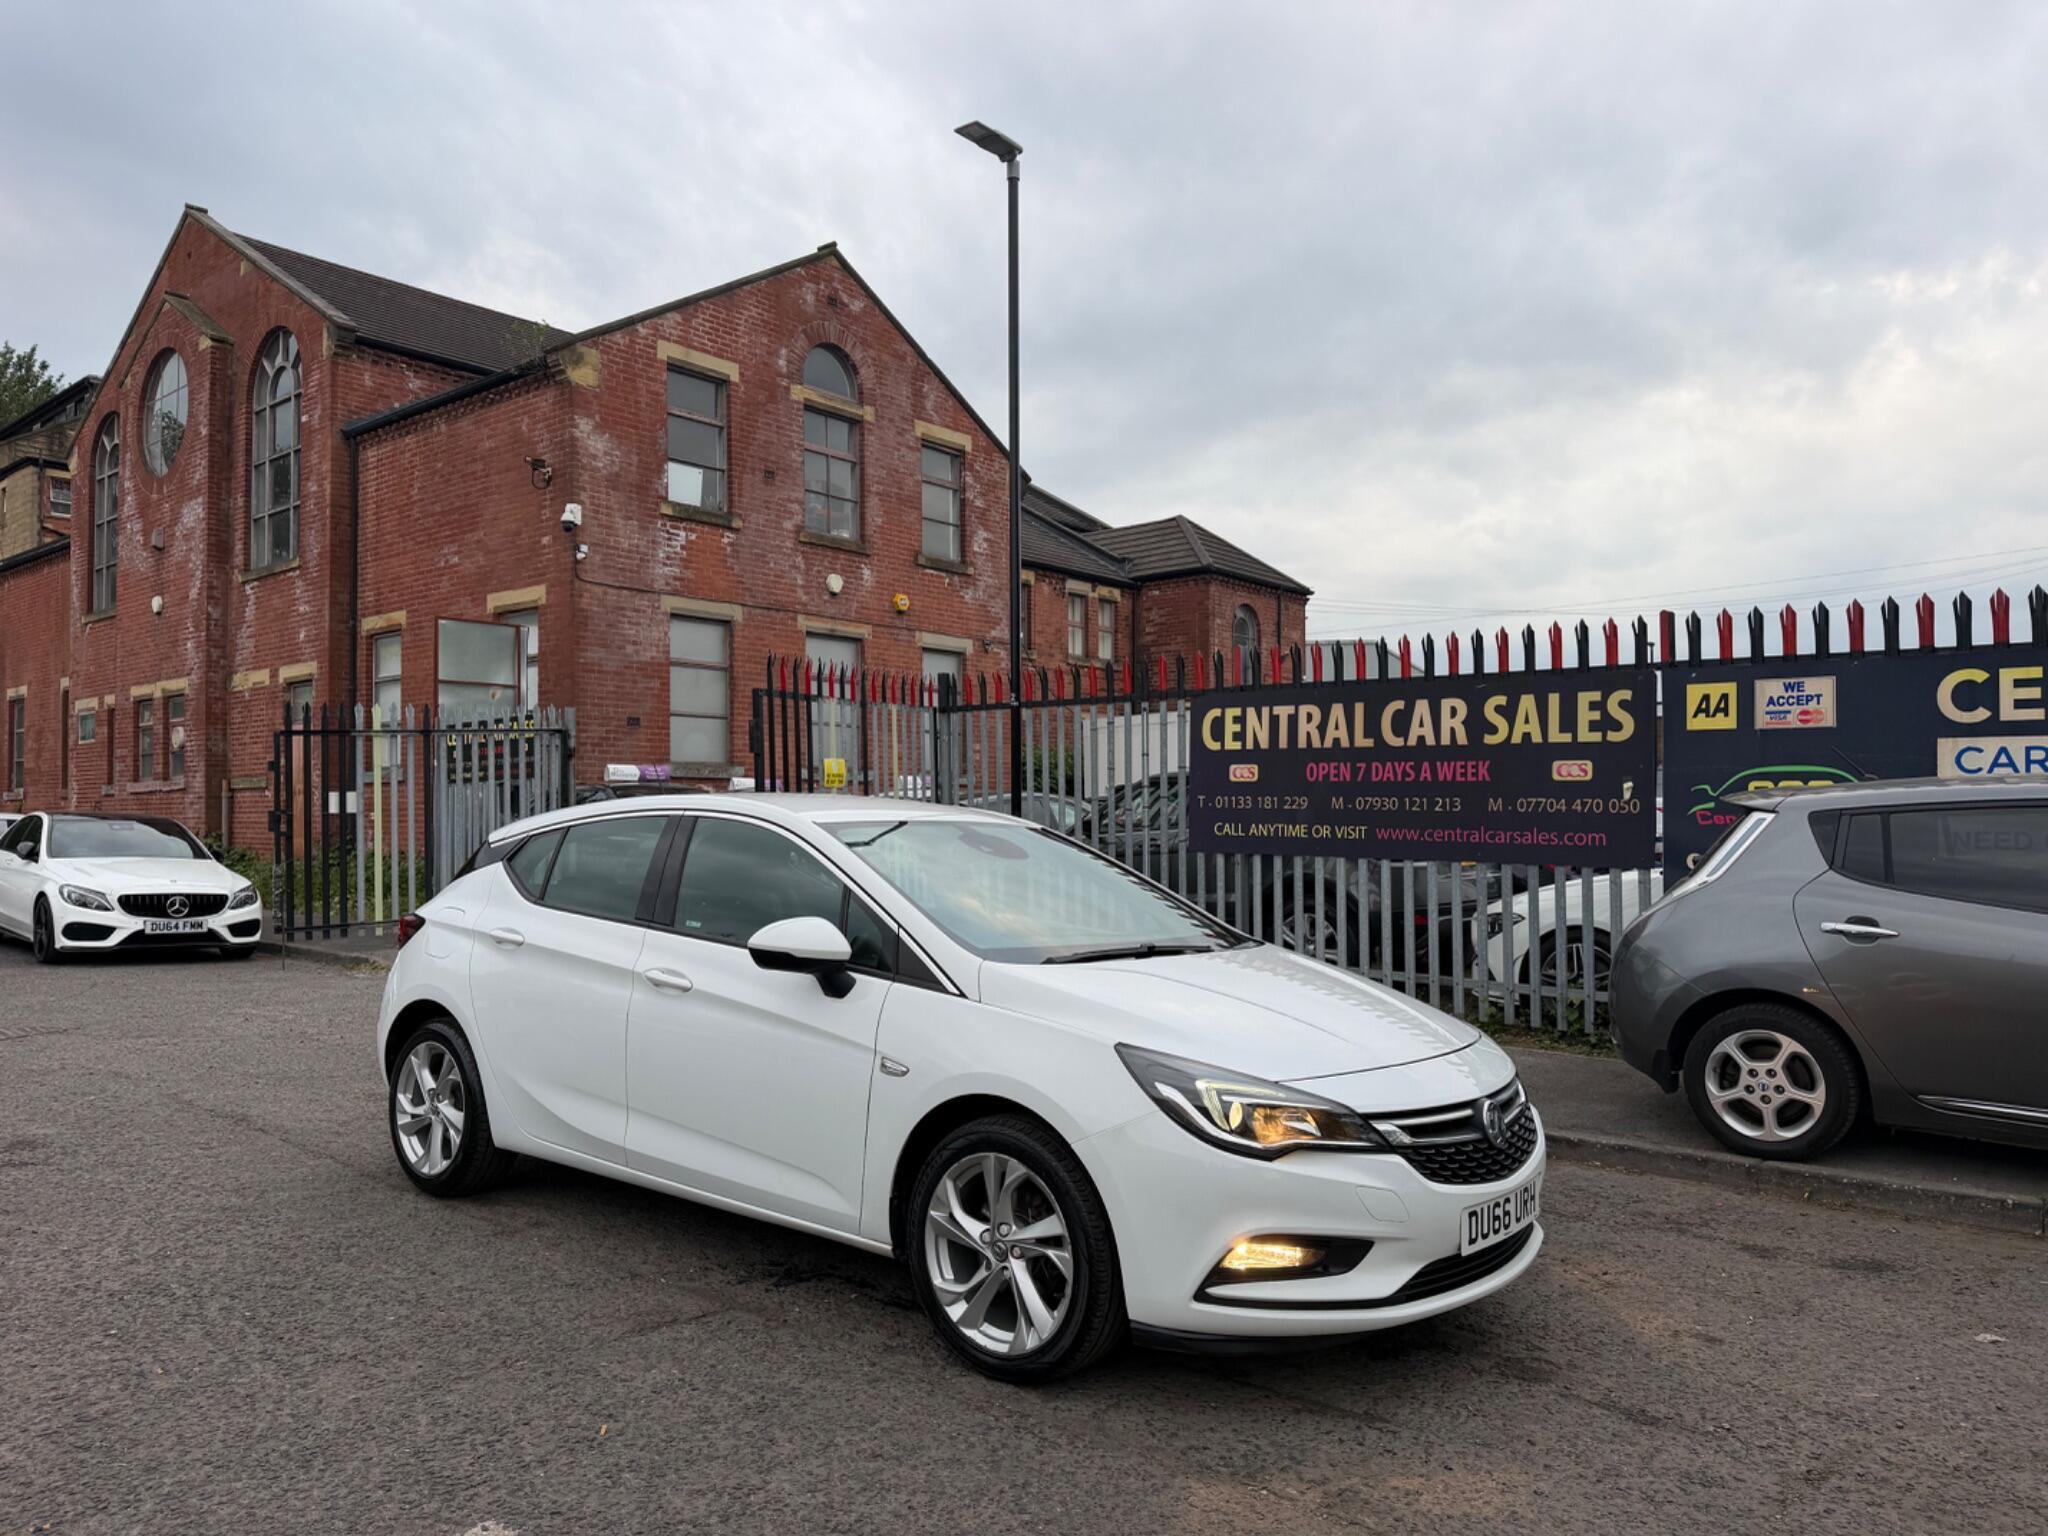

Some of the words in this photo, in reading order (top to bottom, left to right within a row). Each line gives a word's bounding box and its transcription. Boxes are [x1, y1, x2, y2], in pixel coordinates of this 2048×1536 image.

[1783, 680, 1806, 693] WE
[1692, 692, 1731, 719] AA
[1766, 693, 1824, 708] ACCEPT
[1201, 701, 1375, 751] CENTRAL
[1381, 697, 1469, 747] CAR
[1483, 689, 1636, 745] SALES
[1306, 762, 1351, 782] OPEN
[1355, 762, 1367, 782] 7
[1371, 761, 1416, 782] DAYS
[1419, 761, 1432, 781] A
[1436, 760, 1491, 782] WEEK
[1215, 796, 1252, 809] 01133
[1257, 796, 1278, 809] 181
[1283, 796, 1309, 809] 229
[1355, 797, 1399, 811] 07930
[1404, 797, 1428, 811] 121
[1434, 797, 1462, 812] 213
[1516, 798, 1567, 812] 07704
[1571, 799, 1603, 813] 470
[1608, 799, 1640, 814] 050
[1214, 823, 1245, 836] CALL
[1249, 823, 1308, 838] ANYTIME
[1312, 825, 1332, 838] OR
[1335, 826, 1368, 839] VISIT
[1375, 826, 1607, 846] www.centralcarsales.com
[151, 922, 180, 931] DU64
[1468, 1197, 1511, 1246] DU66
[1515, 1179, 1536, 1223] URH
